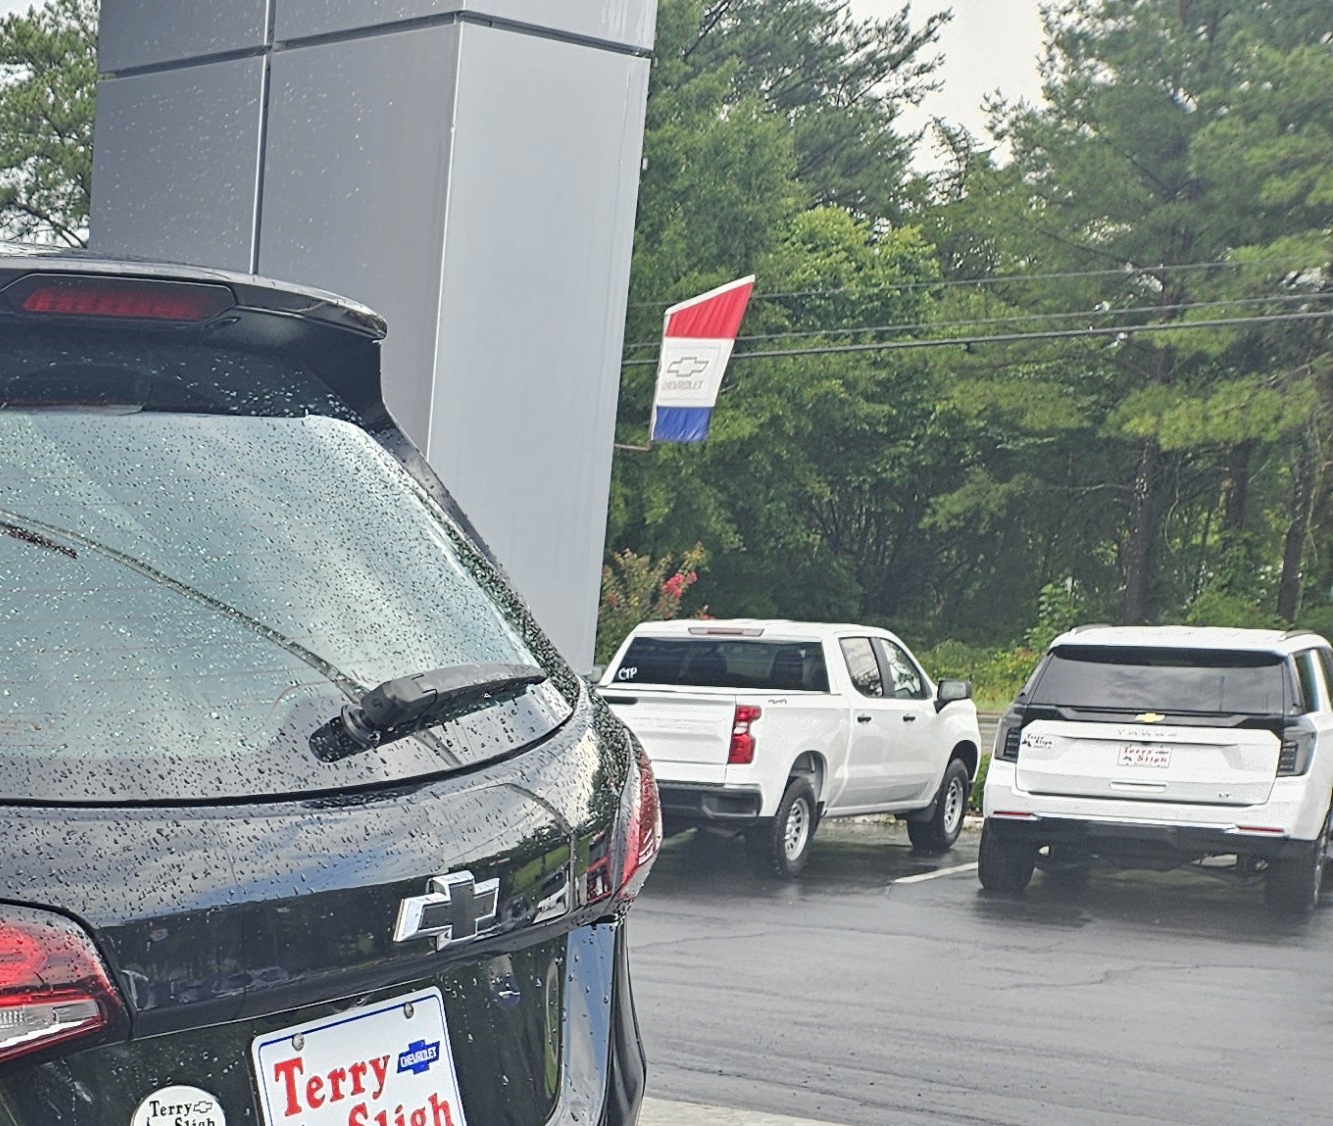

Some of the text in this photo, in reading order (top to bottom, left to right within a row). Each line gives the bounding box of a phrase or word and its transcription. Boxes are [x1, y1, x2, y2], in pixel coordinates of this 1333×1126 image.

[275, 1046, 437, 1117] Terry CHEVROLET
[149, 1100, 192, 1117] Terry
